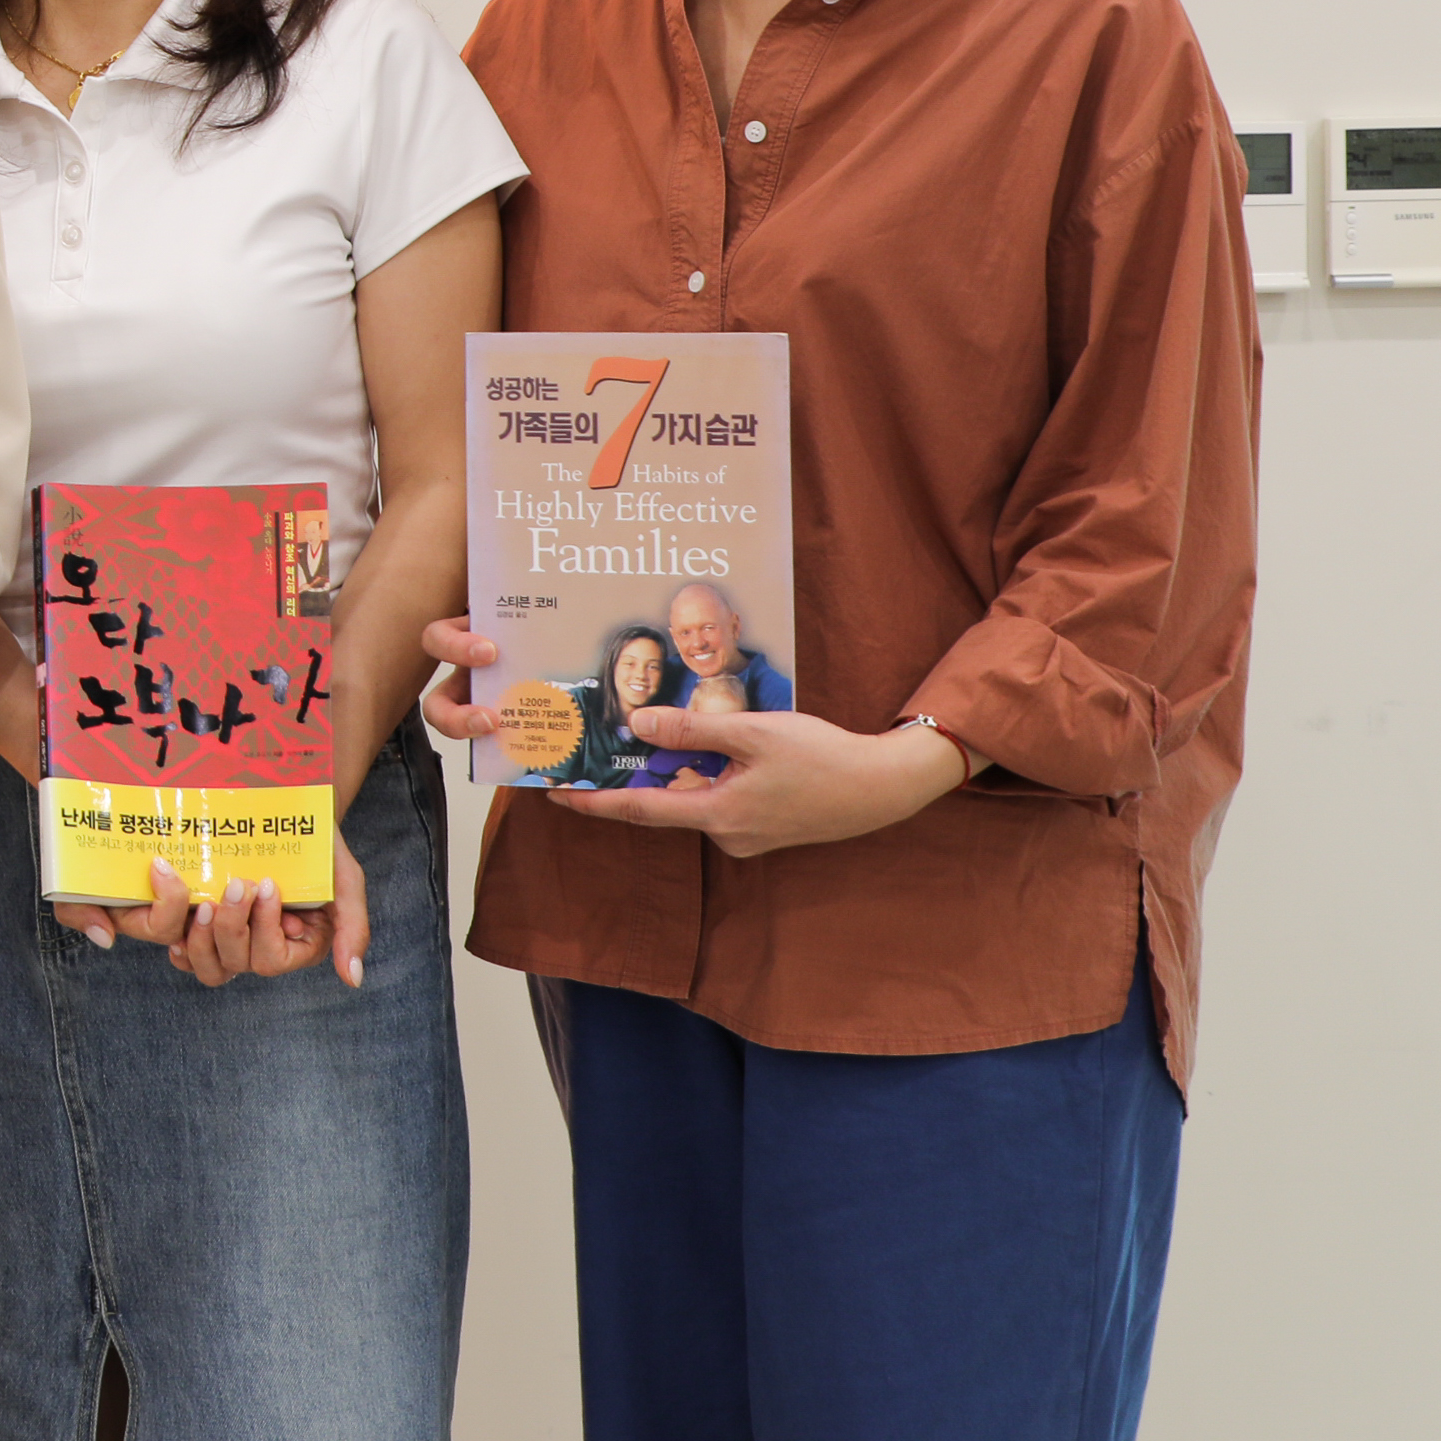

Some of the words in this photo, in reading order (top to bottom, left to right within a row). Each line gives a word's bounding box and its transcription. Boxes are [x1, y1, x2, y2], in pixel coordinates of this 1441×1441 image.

[1393, 212, 1436, 221] SAMSUNG
[485, 376, 559, 402] 성공하는
[498, 411, 599, 444] 가족들의
[583, 356, 671, 490] 7
[651, 413, 759, 446] 가지습관
[541, 462, 583, 482] The
[631, 463, 700, 485] Habits
[705, 464, 729, 484] of
[494, 489, 604, 528] Highly
[613, 491, 758, 524] Effective
[527, 526, 730, 578] Families
[285, 565, 296, 595] 혁신의
[286, 597, 296, 617] 리더
[495, 596, 531, 609] 스티븐
[534, 596, 558, 610] 코비
[60, 807, 113, 832] 난세를
[118, 813, 174, 836] 평정한
[181, 816, 255, 838] 카리스마
[262, 814, 315, 836] 리더십
[75, 834, 98, 849] 일본
[99, 837, 121, 850] 최고
[254, 841, 275, 856] 열광
[279, 841, 302, 855] 시킨
